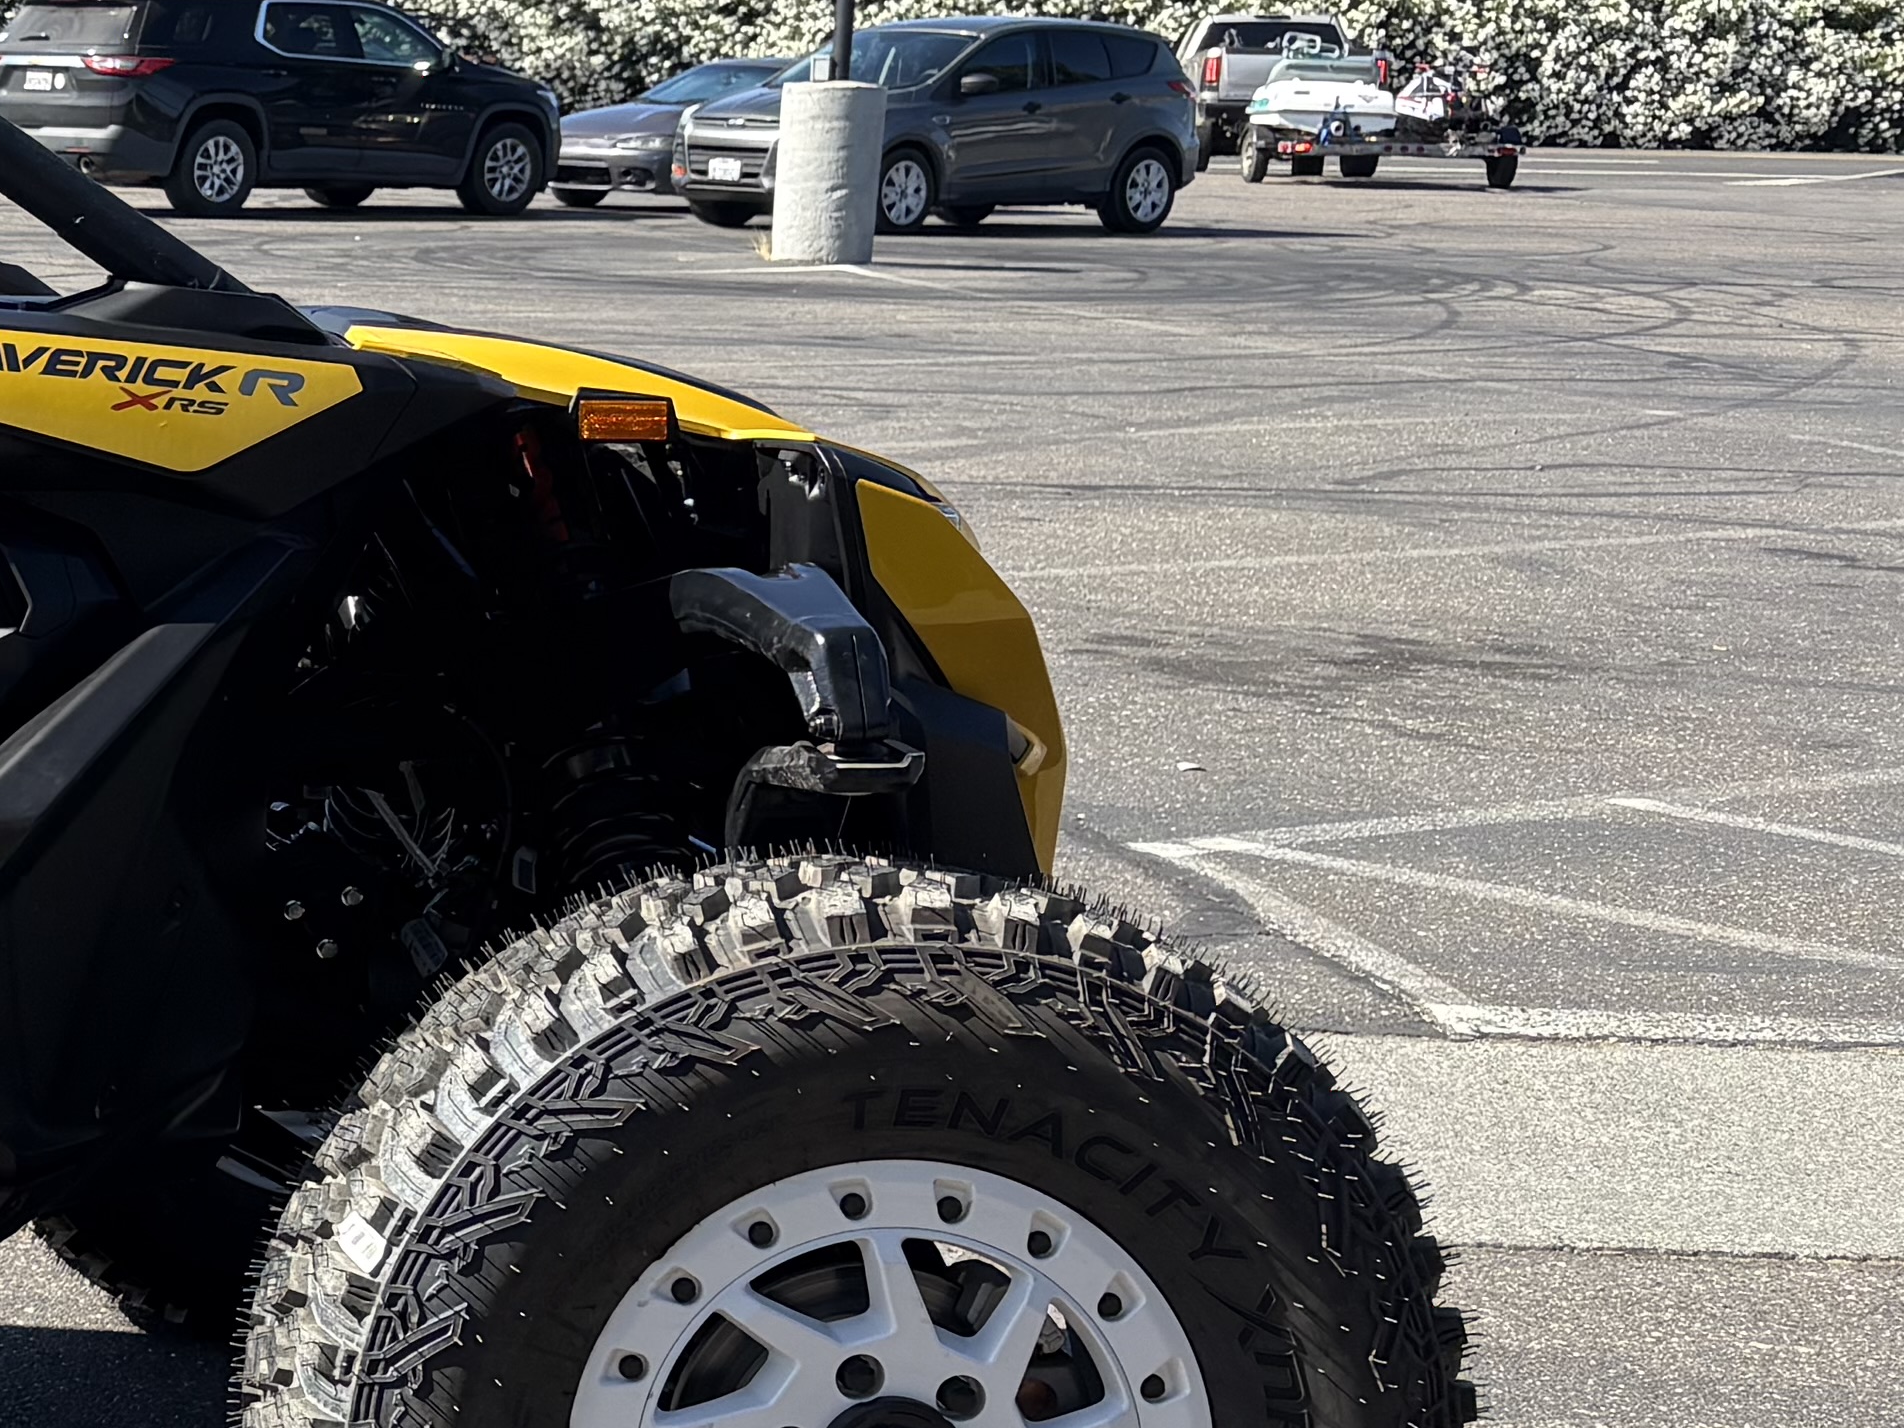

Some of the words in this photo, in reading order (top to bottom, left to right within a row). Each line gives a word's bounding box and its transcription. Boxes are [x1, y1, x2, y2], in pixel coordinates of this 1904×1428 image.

[111, 388, 229, 416] XRS
[239, 368, 303, 406] R
[841, 1085, 1250, 1264] TENACITY
